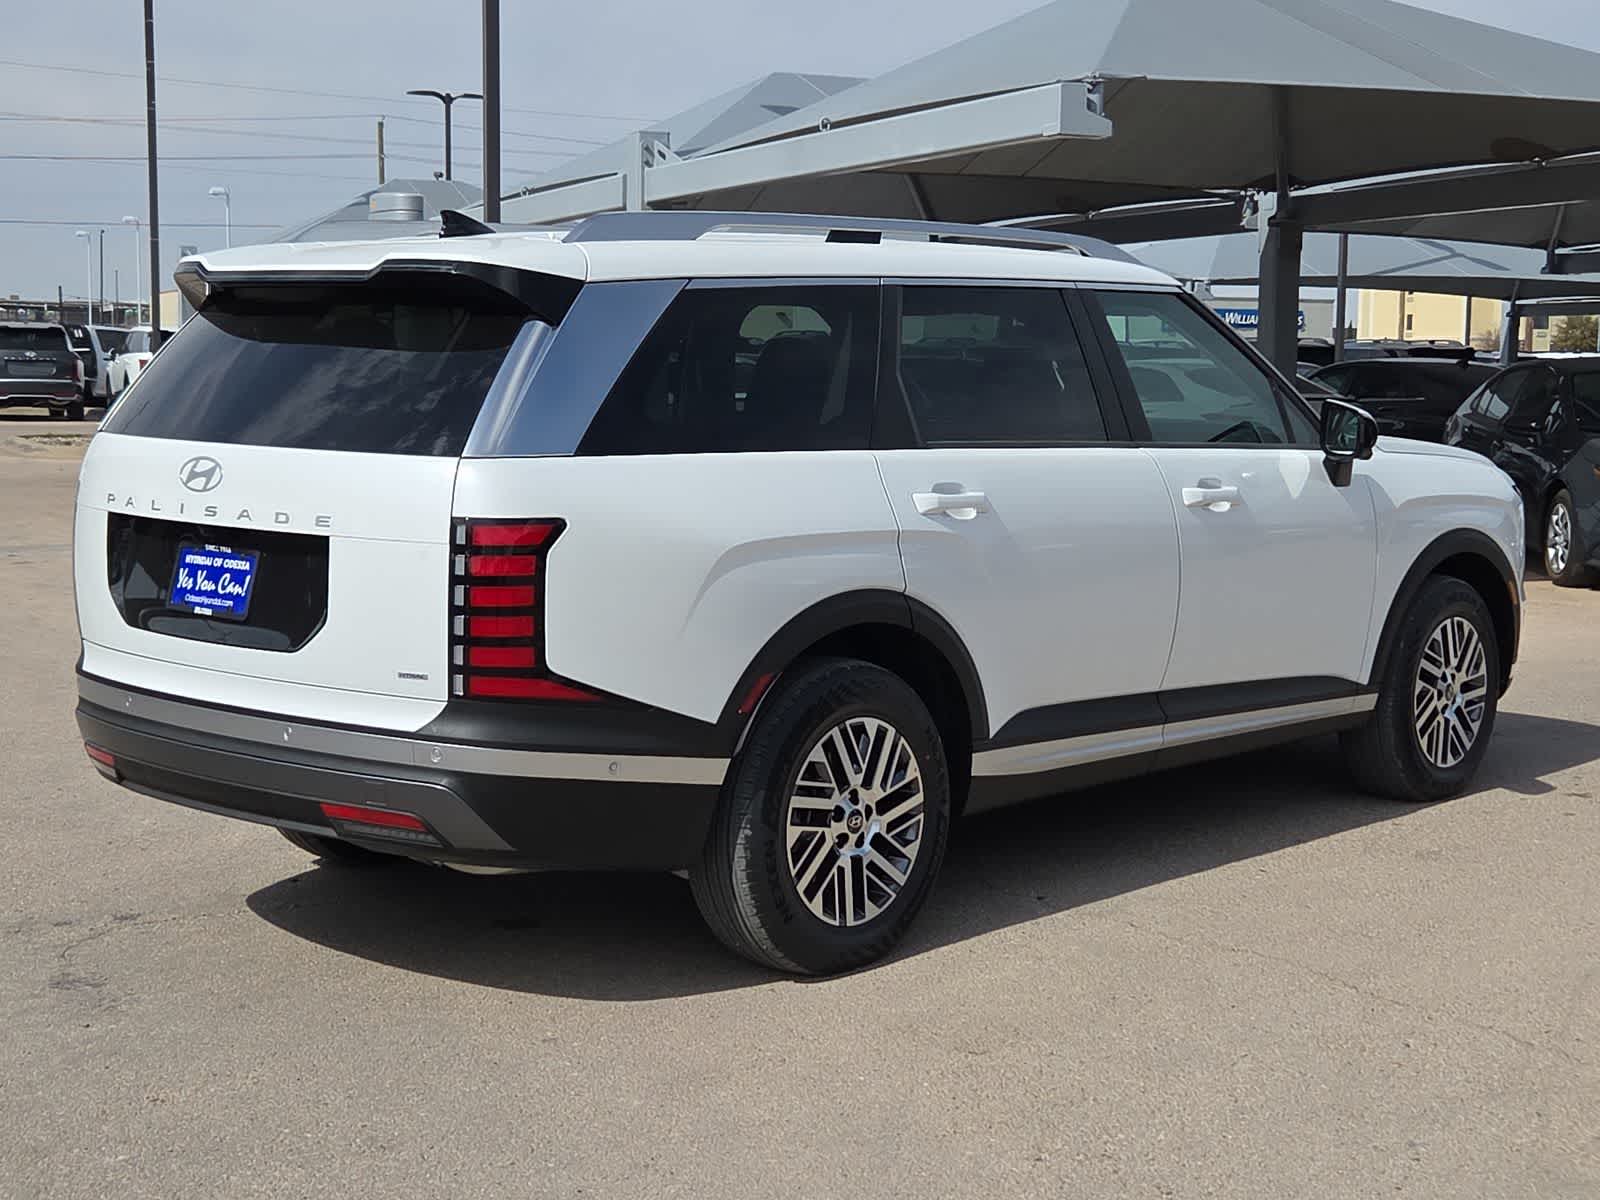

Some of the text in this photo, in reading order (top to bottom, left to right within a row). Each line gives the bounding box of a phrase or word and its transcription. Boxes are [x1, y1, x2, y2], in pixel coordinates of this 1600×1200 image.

[106, 492, 332, 528] PALISADE
[185, 554, 250, 571] HYUNDAI OF ODESSA
[177, 567, 251, 597] Yes You Can!
